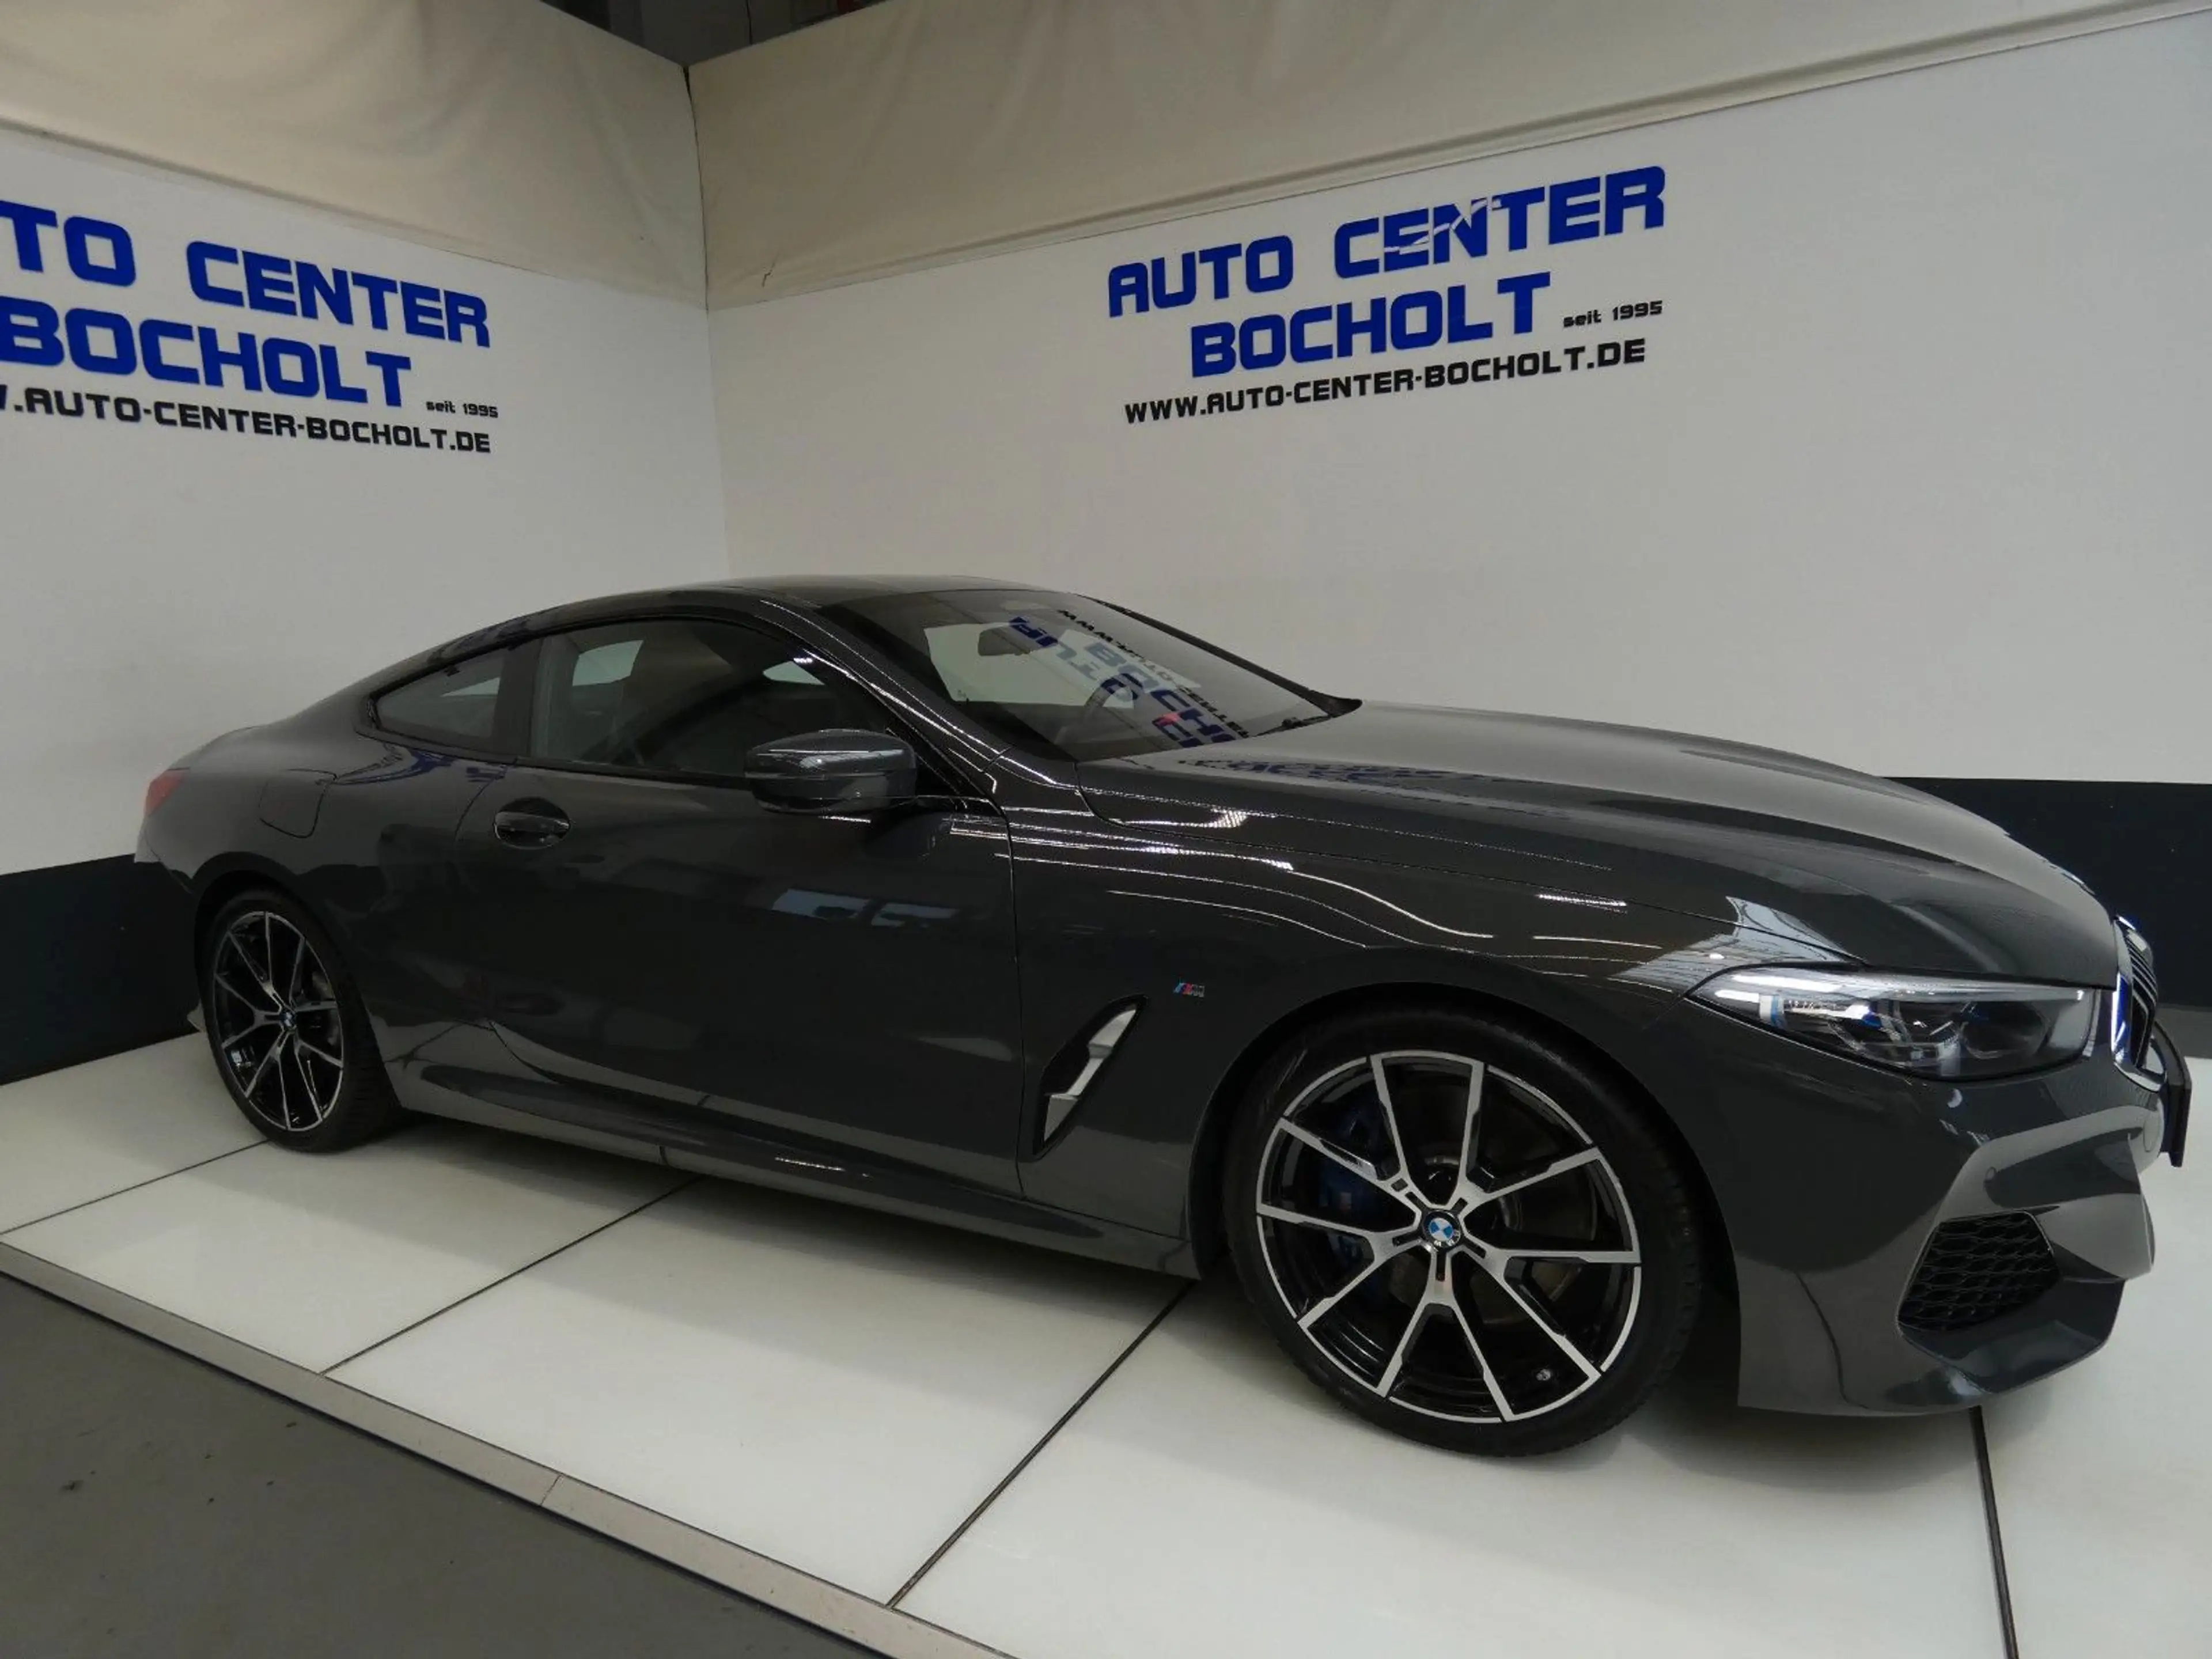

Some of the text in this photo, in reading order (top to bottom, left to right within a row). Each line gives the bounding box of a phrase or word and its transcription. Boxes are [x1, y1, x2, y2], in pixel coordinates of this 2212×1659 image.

[1108, 166, 1665, 317] AUTO CENTER
[187, 241, 490, 348] CENTER
[1191, 273, 1662, 377] BOCHOLT seit 1995
[0, 296, 498, 418] BOCHOLT seit 1995
[1125, 338, 1645, 424] WWW.AUTO-CENTER-BOCHOLT.DE
[0, 384, 490, 453] .AUTO-CENTER-BOCHOLT.DE
